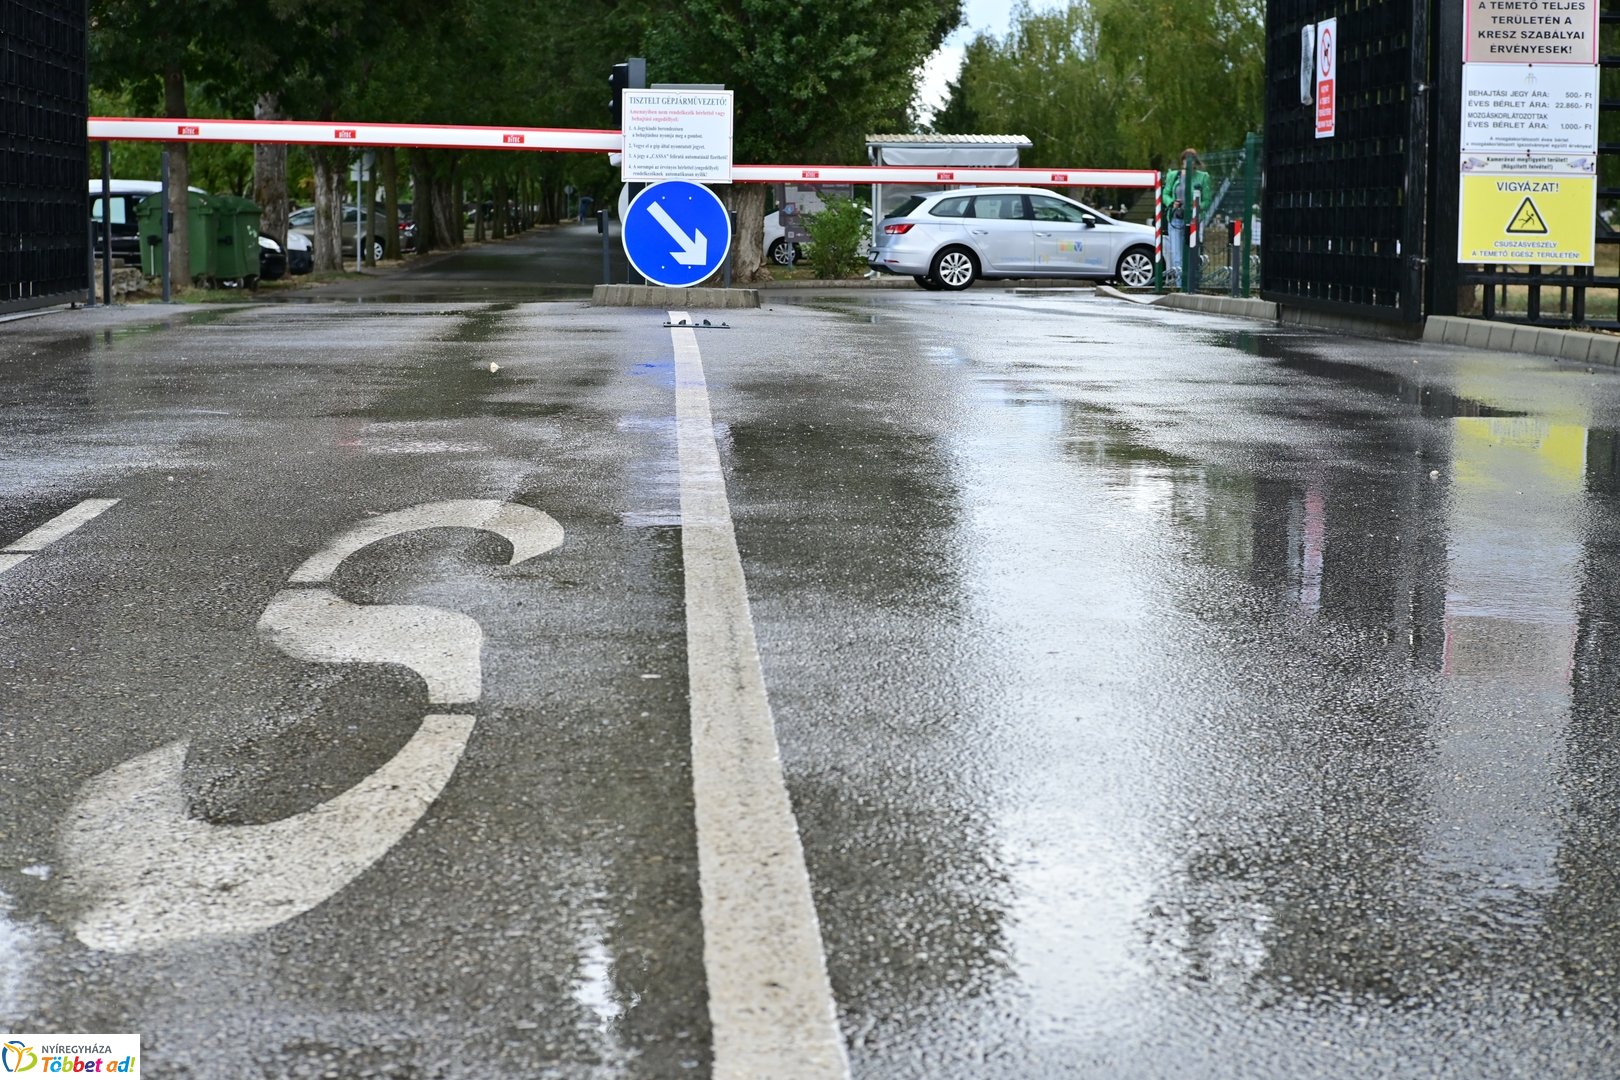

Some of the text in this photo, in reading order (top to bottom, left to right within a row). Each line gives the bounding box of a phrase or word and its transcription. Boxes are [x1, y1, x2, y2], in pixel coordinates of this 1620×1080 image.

[1490, 0, 1538, 9] TEMETŐ
[1492, 15, 1560, 24] TERÜLETÉN
[1521, 29, 1584, 39] SZABÁLYAI
[1490, 44, 1572, 53] ÉRVÉNYESEK!
[1497, 180, 1559, 192] VIGYÁZAT!
[1494, 239, 1557, 247] CSÚSZÁSVESZÉLY
